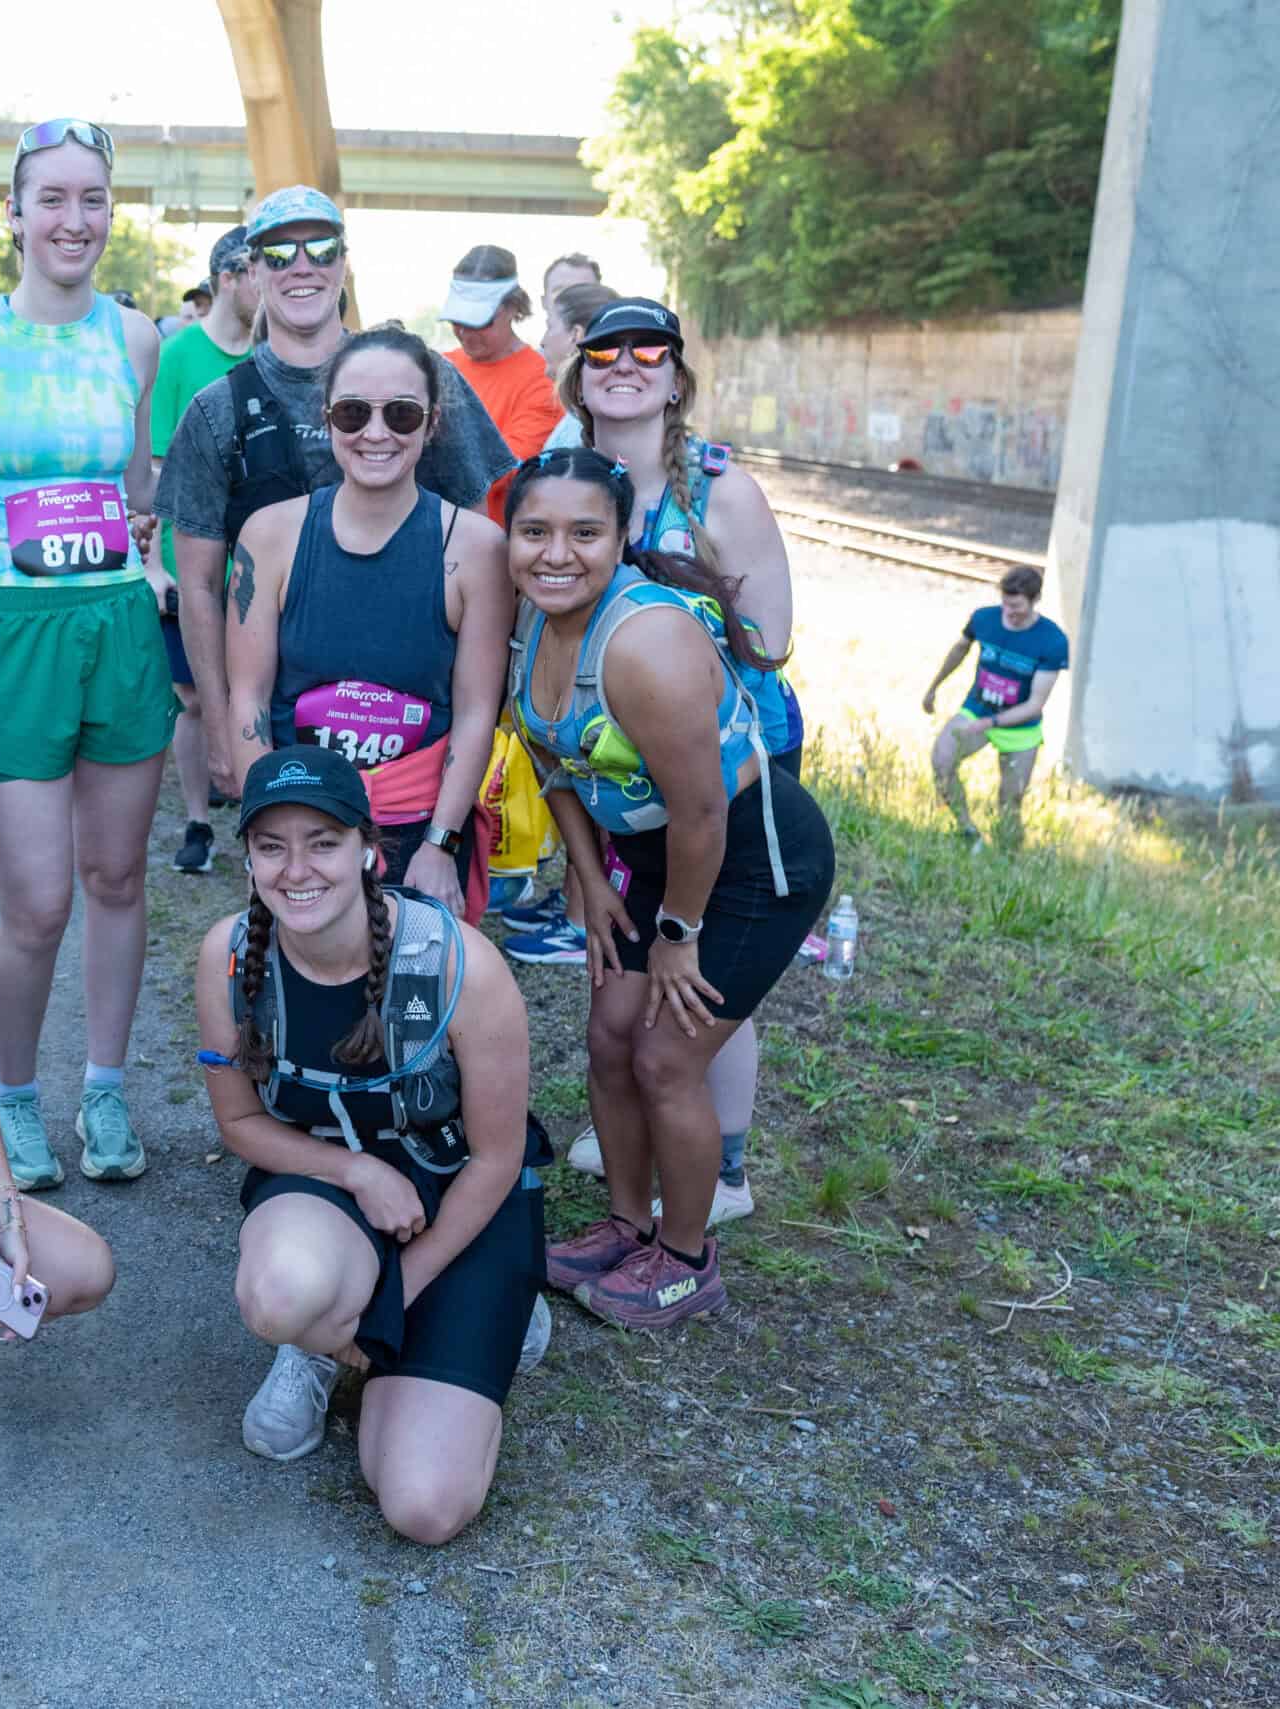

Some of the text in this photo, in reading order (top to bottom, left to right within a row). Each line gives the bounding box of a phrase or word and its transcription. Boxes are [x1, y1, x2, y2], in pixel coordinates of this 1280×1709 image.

[39, 488, 93, 507] riverrock
[41, 532, 105, 568] 870
[336, 689, 394, 703] riverrock
[314, 726, 405, 765] 1349
[657, 1276, 697, 1308] HOKA
